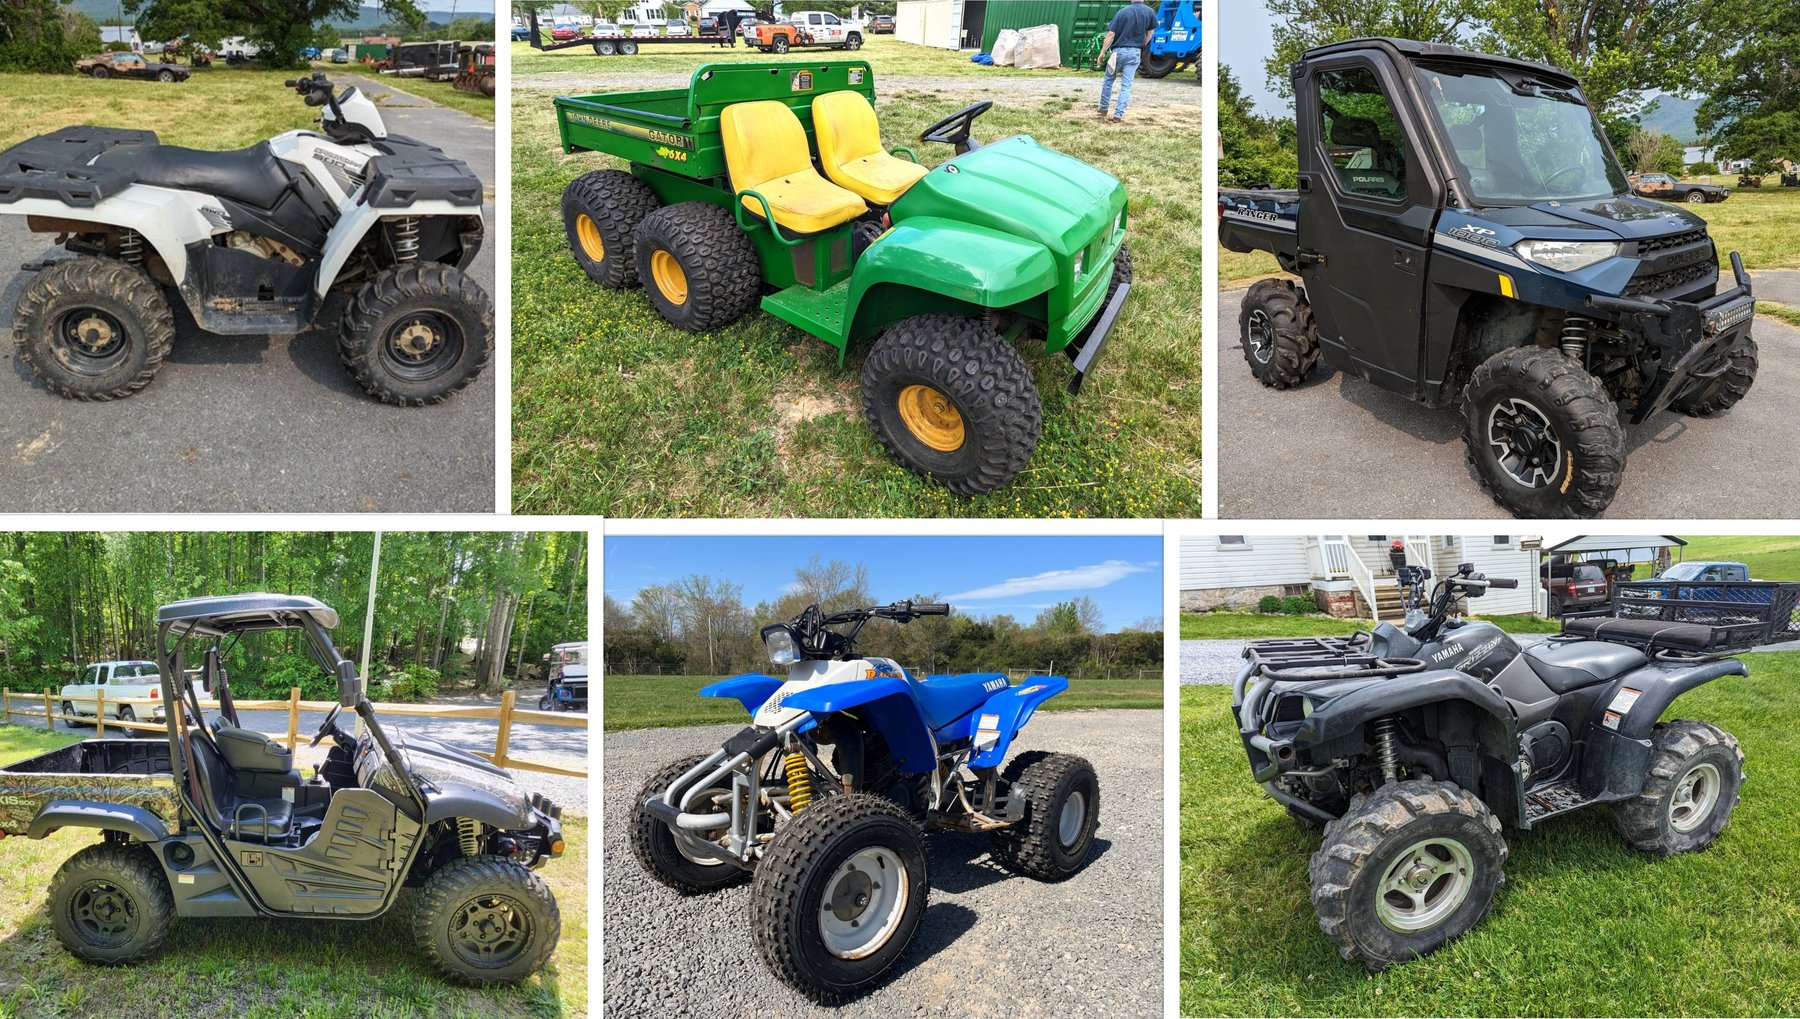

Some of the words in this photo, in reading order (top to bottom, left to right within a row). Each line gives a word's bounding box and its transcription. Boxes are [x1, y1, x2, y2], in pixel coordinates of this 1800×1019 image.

[571, 113, 587, 125] JOHN
[588, 116, 612, 130] DEERE
[648, 130, 684, 147] GATOR
[312, 153, 345, 168] 500
[669, 150, 687, 162] 6X4
[1237, 207, 1278, 221] RANGER
[1448, 227, 1500, 247] 1000
[1461, 224, 1496, 235] XP
[1432, 642, 1464, 663] YAMAHA
[982, 677, 1008, 692] YAMAHA
